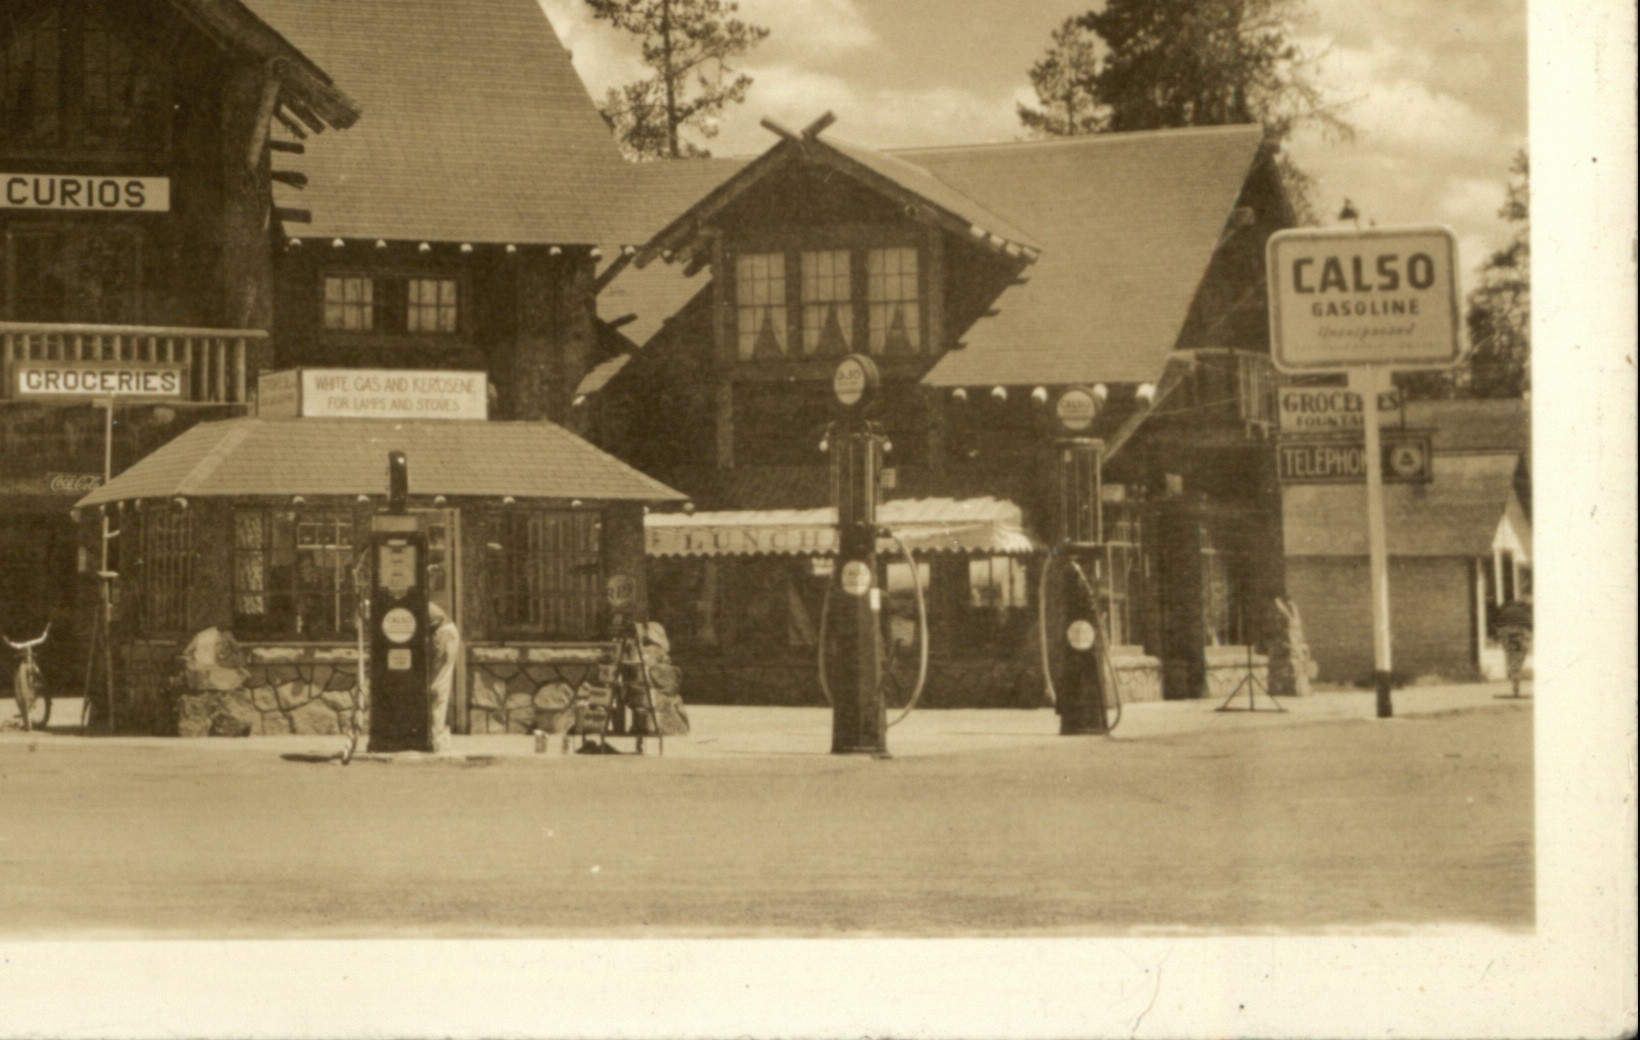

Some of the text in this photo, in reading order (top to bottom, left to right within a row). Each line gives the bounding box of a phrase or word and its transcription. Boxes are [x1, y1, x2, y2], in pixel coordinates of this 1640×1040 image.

[6, 177, 146, 208] CURIOS
[1292, 252, 1435, 294] CALSO
[1311, 299, 1420, 318] GASOLINE
[26, 369, 176, 392] GROCERIES
[314, 375, 349, 392] WHITE
[354, 376, 380, 392] GAS
[385, 377, 409, 392] AND
[413, 376, 477, 394] KEROSENE
[328, 397, 460, 411] FOR LAMPS AND STOVES
[1283, 391, 1399, 412] GROCEES
[1297, 415, 1365, 428] FOUNTAI
[685, 529, 821, 550] LUNCH
